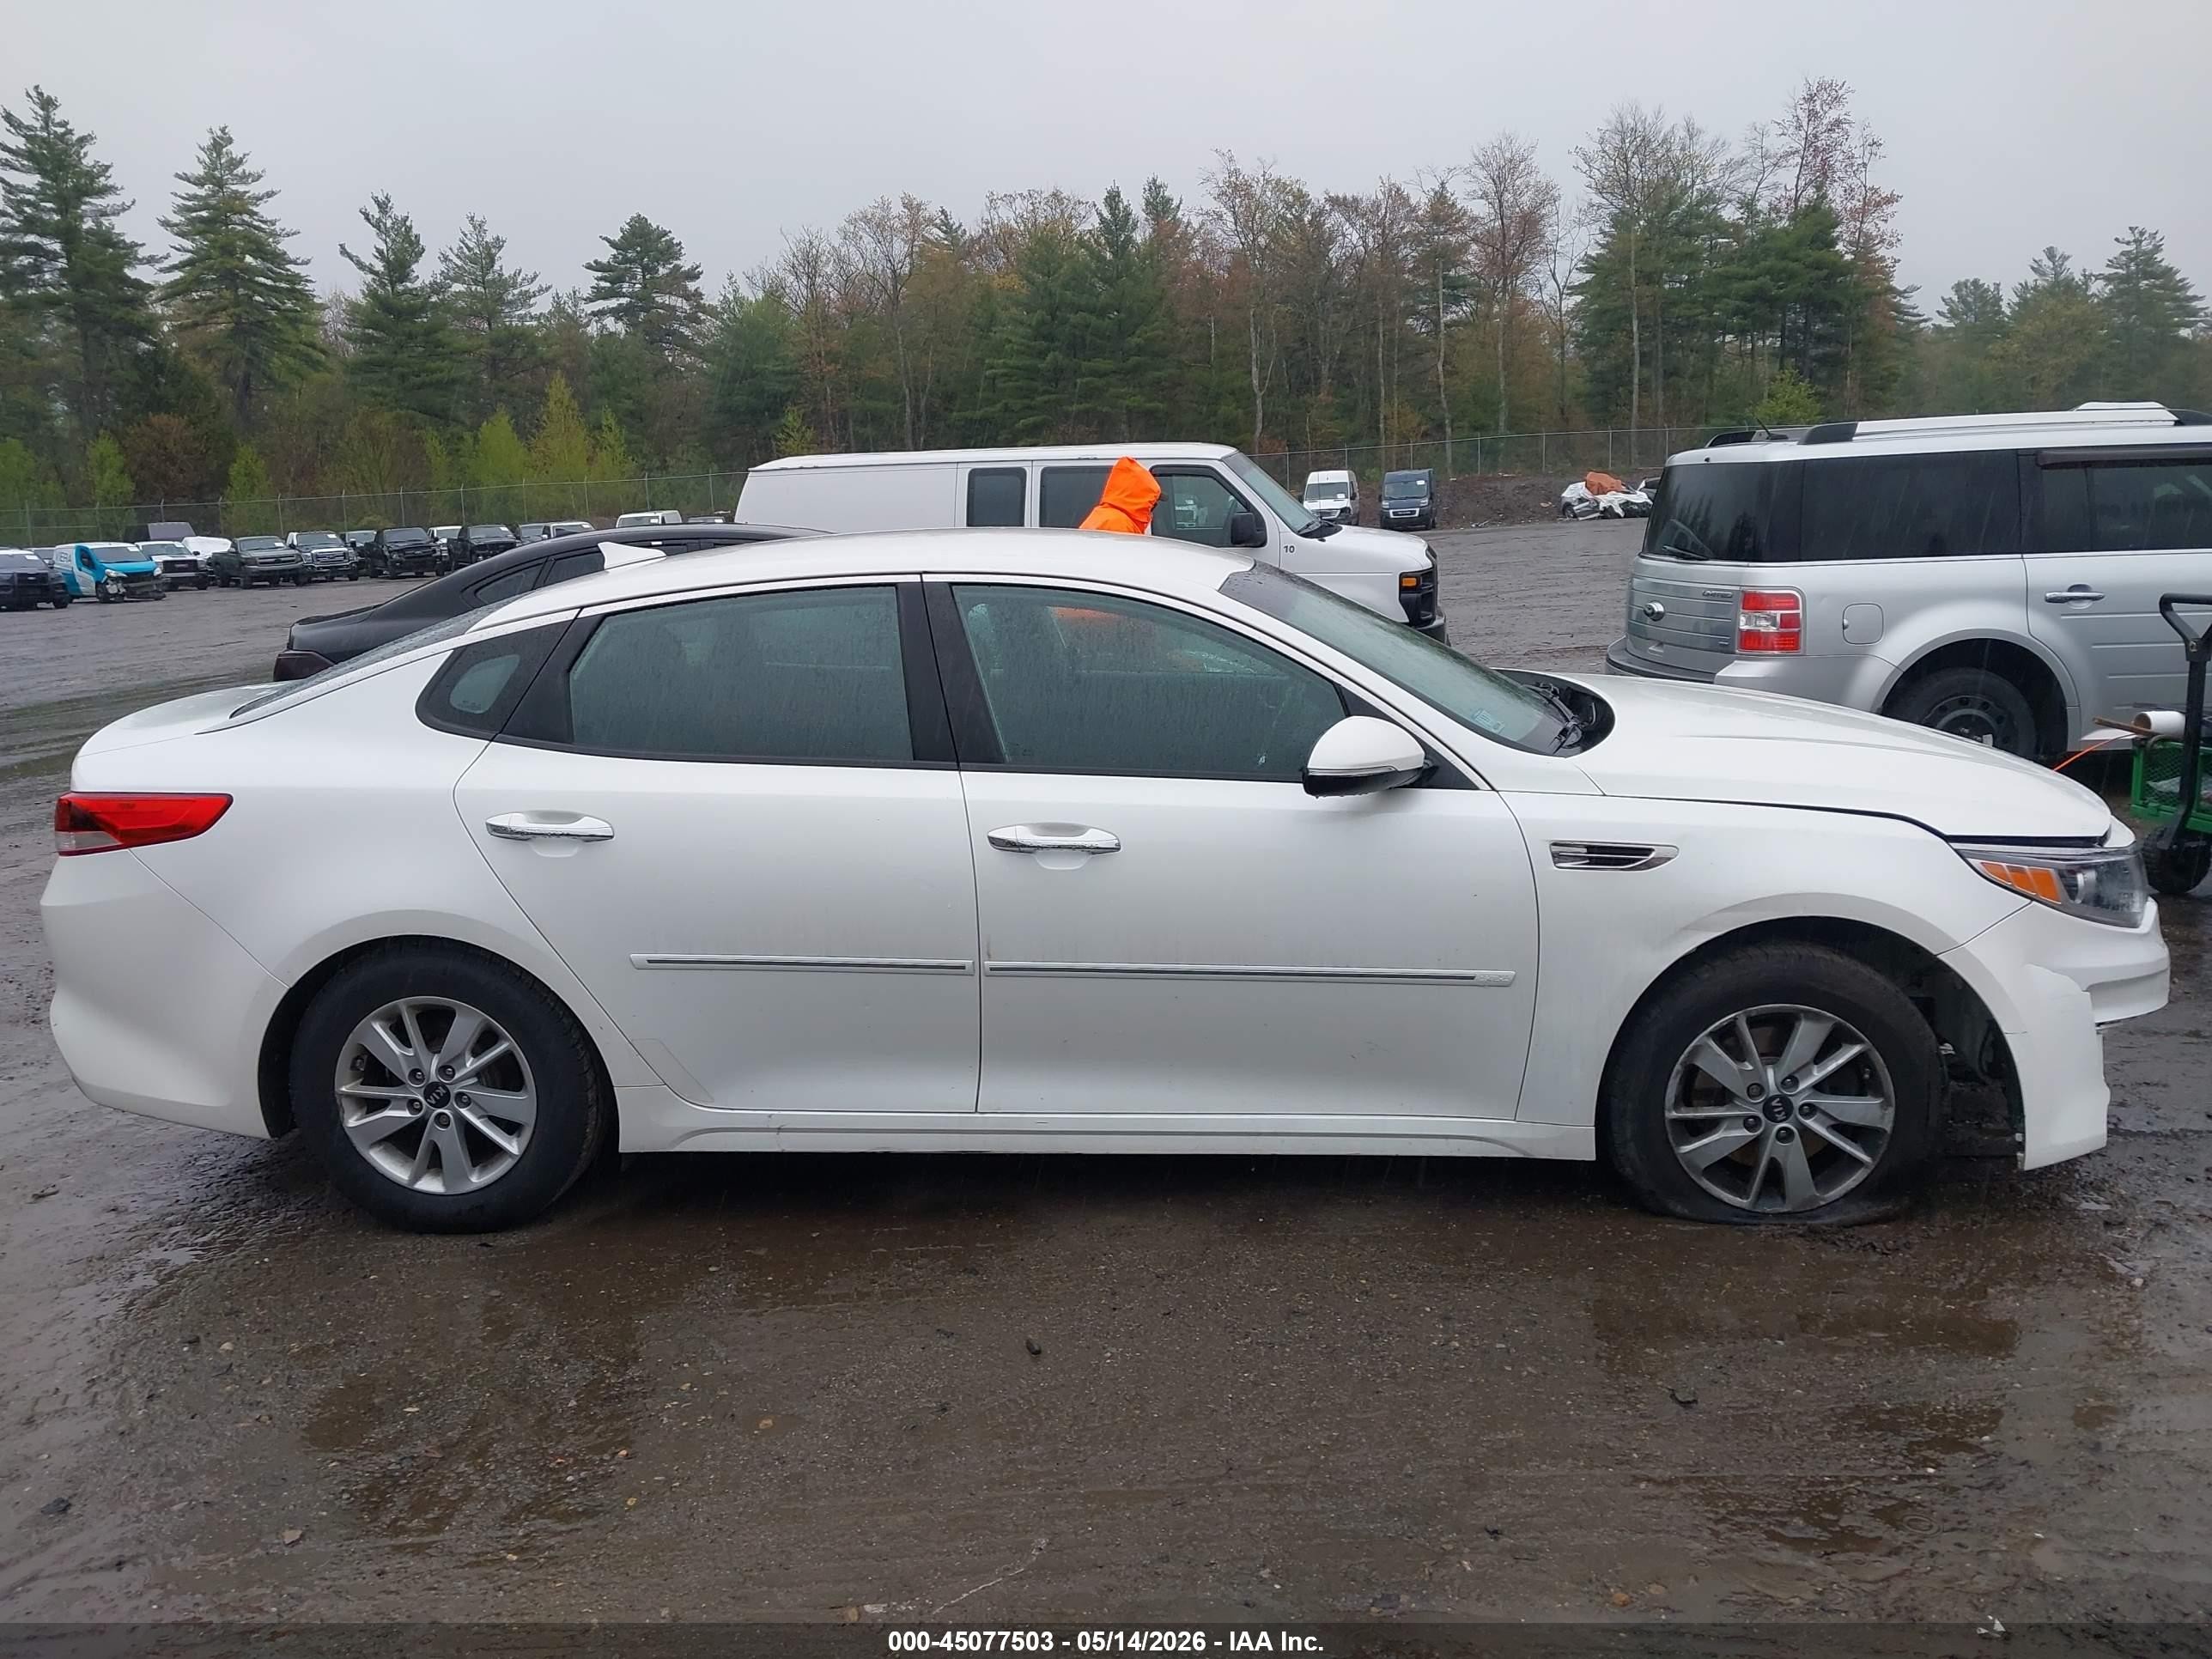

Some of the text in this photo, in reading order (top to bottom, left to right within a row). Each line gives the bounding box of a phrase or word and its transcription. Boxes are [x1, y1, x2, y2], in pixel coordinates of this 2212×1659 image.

[1284, 545, 1295, 554] 10
[427, 1085, 447, 1104] KIA
[1771, 1097, 1787, 1121] KIA
